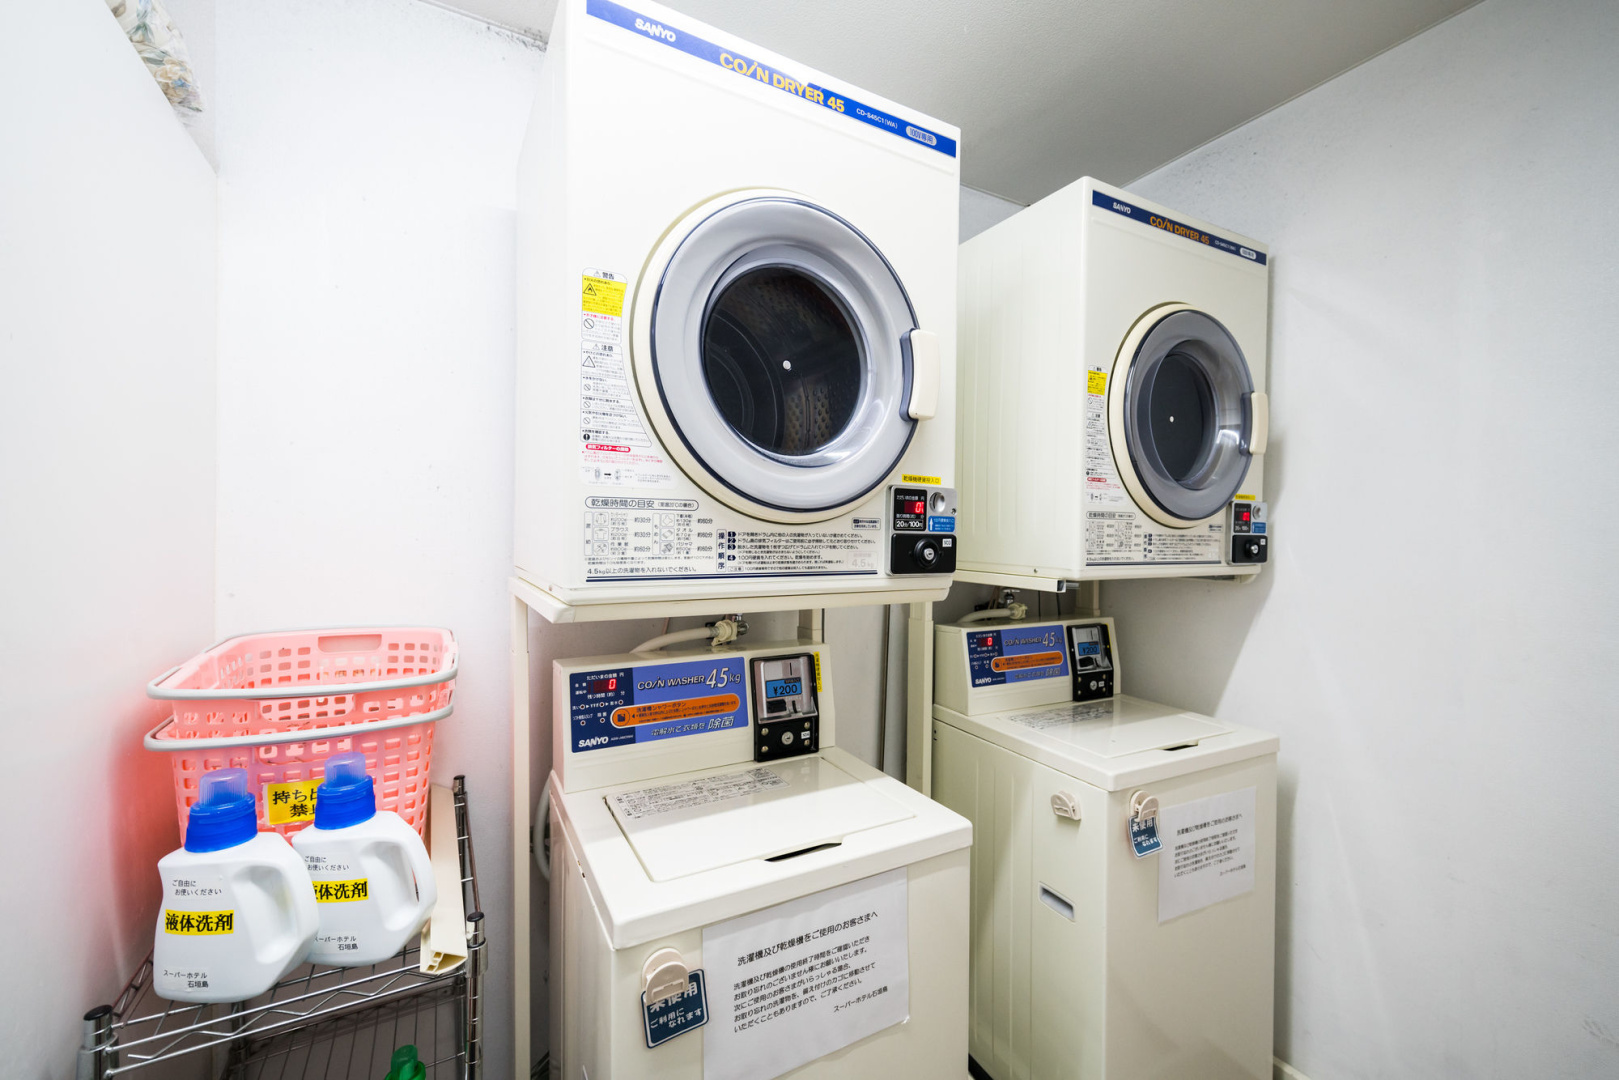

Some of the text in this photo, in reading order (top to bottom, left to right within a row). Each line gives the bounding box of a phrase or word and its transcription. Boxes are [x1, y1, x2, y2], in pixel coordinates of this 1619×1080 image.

[634, 18, 677, 43] SANYO
[719, 53, 845, 113] COIN DRYER 45
[1112, 202, 1132, 214] SANYO
[1150, 216, 1174, 233] COIN
[1174, 225, 1200, 241] DRYER
[1201, 235, 1210, 245] 45
[608, 678, 617, 690] 0
[637, 676, 665, 690] COIN
[667, 675, 705, 687] WASHER
[975, 677, 992, 685] SANYO
[578, 735, 609, 748] SANYO
[165, 912, 233, 932] 液体洗剤
[737, 911, 878, 967] 洗濯機及び乾燥機をご使用のお客さまへ
[338, 943, 358, 951] 石垣島
[163, 970, 207, 979] スーパーホテル
[188, 980, 209, 988] 石垣島
[668, 1007, 702, 1028] なれます
